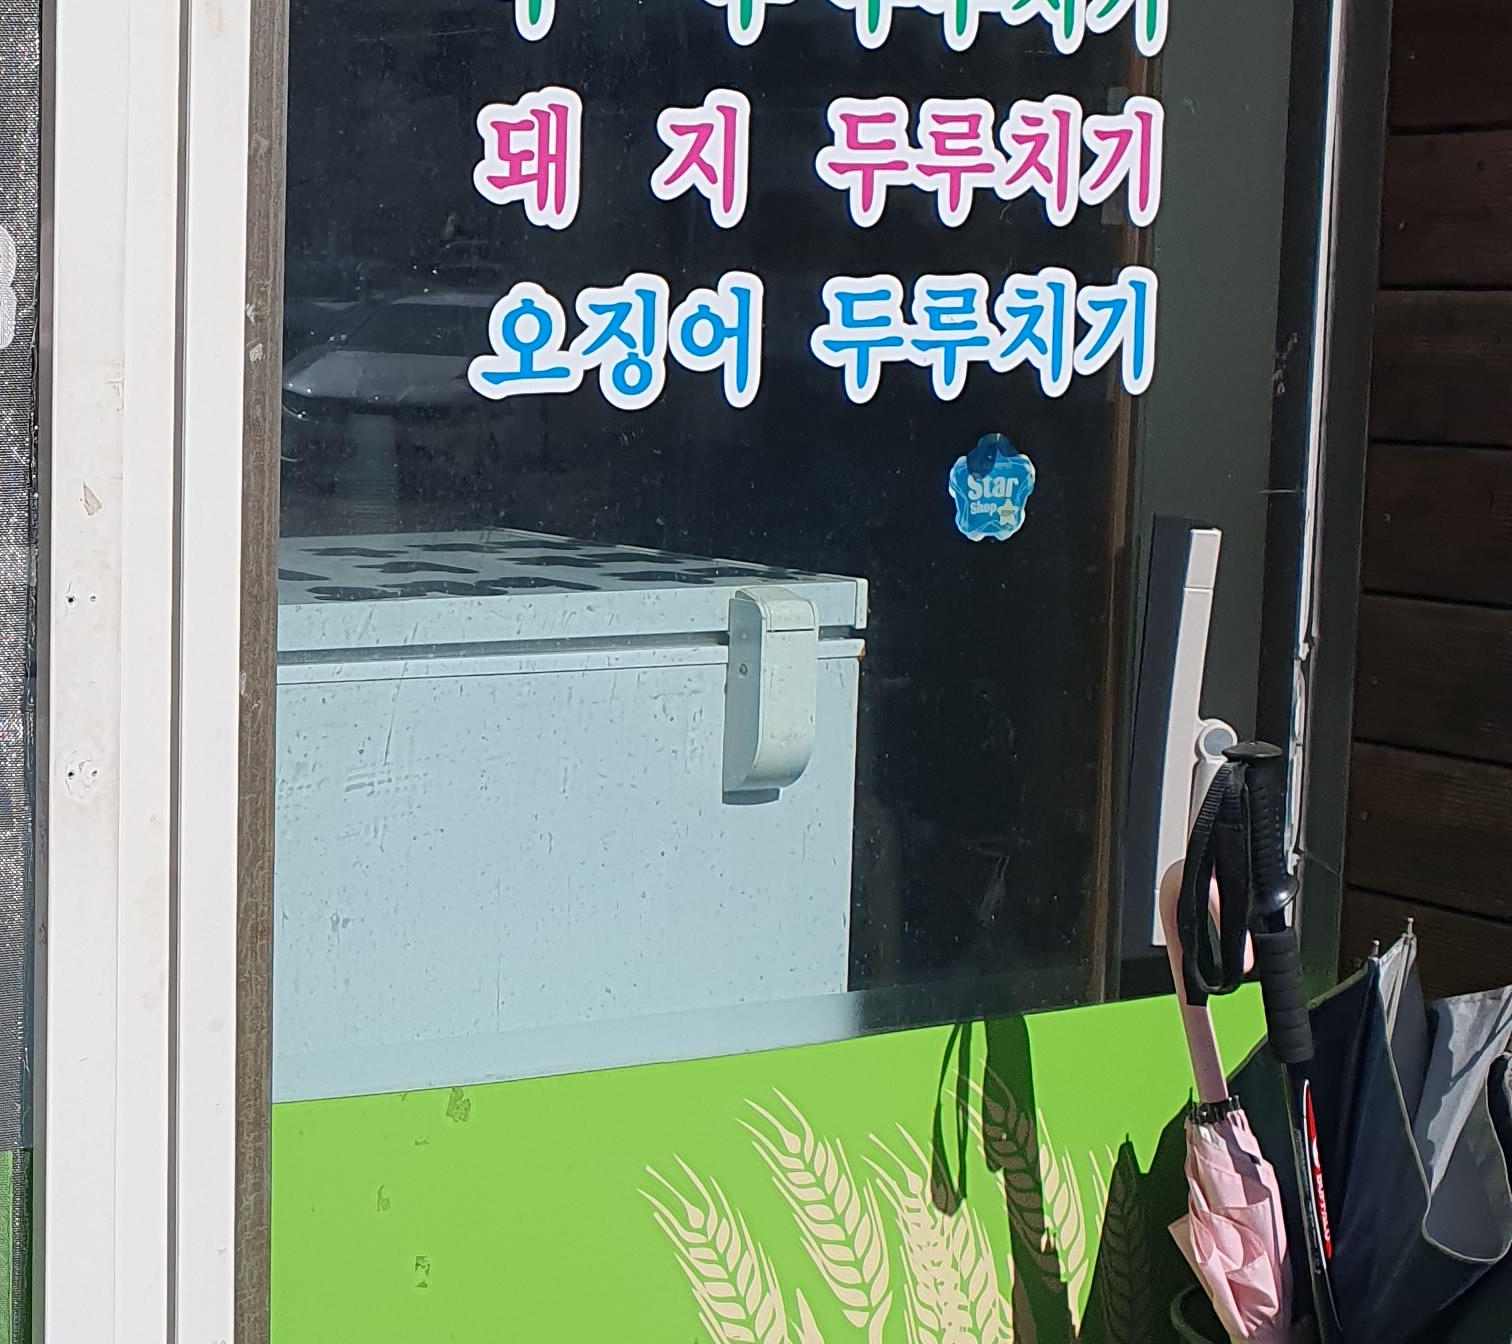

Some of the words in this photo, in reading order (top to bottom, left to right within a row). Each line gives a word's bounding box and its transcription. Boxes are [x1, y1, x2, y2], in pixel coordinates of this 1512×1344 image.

[827, 108, 1154, 215] 두루치기
[479, 287, 751, 398] 오징어
[822, 282, 1148, 392] 두루치기
[968, 474, 1019, 500] Star
[970, 501, 997, 517] Shop
